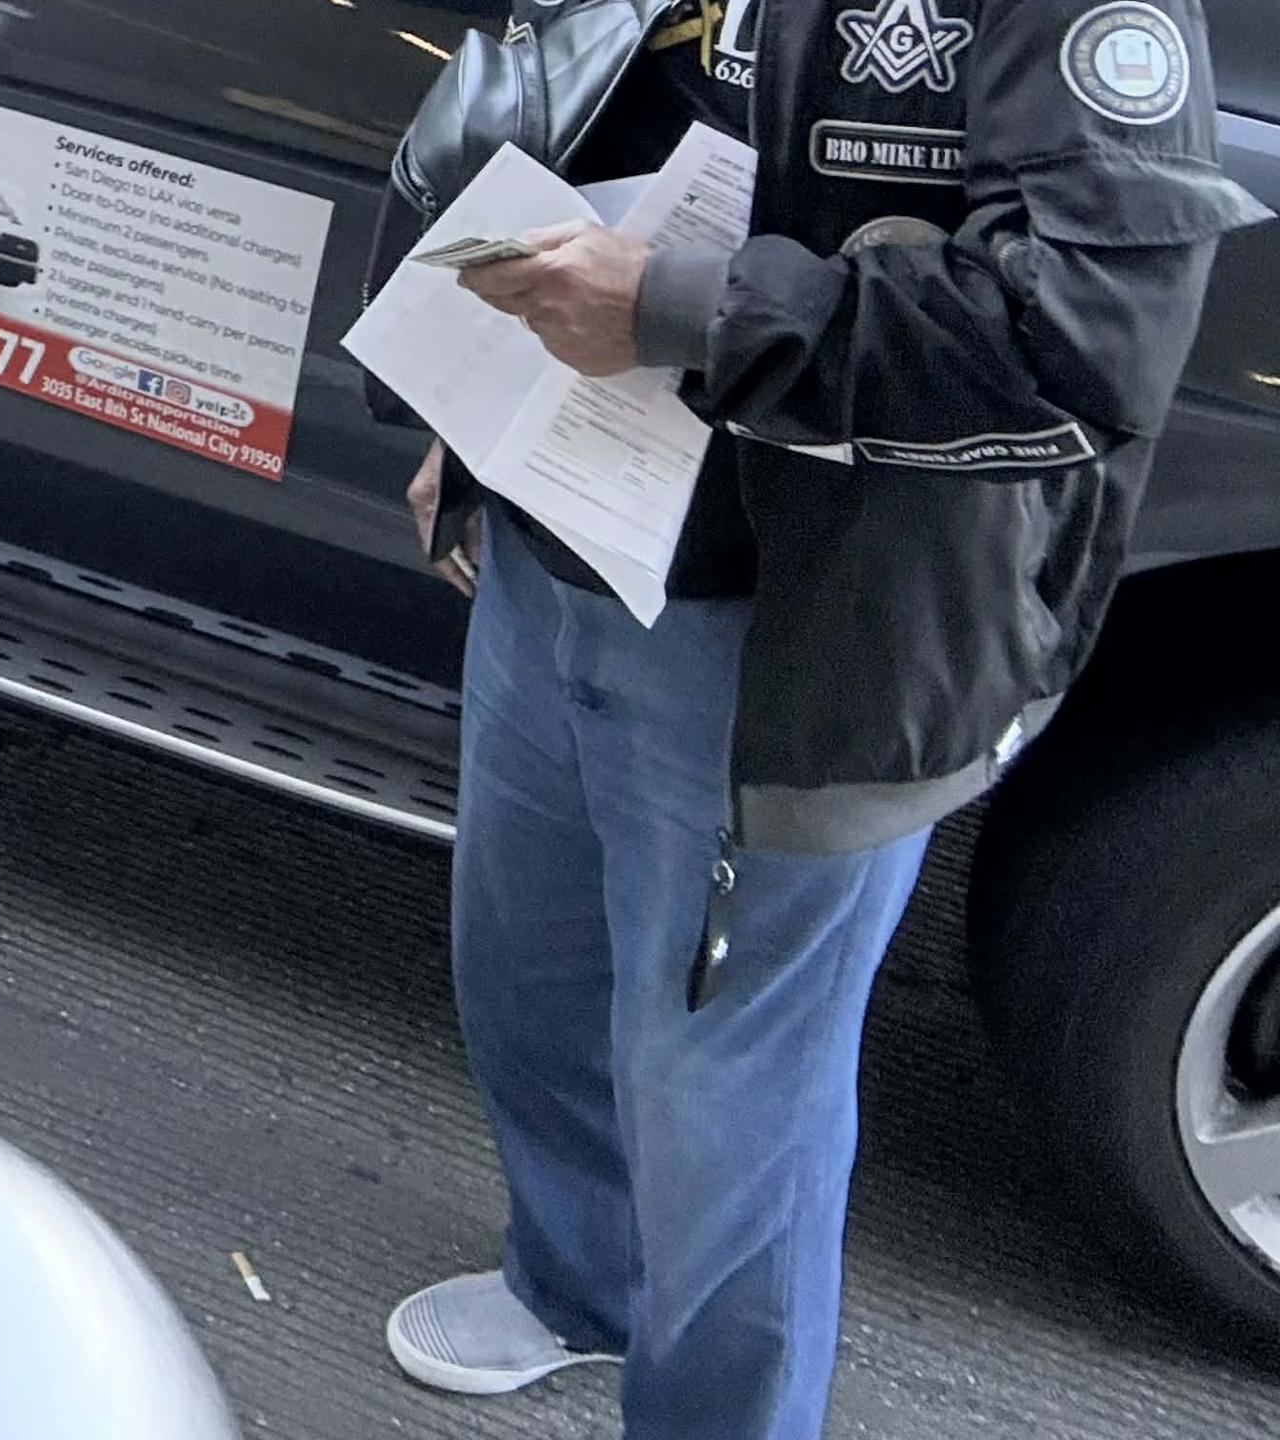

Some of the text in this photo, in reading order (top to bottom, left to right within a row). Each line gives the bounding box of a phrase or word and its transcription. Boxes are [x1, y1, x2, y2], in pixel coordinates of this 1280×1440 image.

[55, 136, 196, 189] Services offered:
[826, 137, 867, 162] BRO
[870, 142, 926, 168] MIKE
[63, 163, 88, 180] San
[91, 171, 130, 194] Diego
[131, 183, 146, 197] to
[149, 188, 176, 206] LAX
[177, 197, 204, 214] vice
[57, 204, 209, 265] Minimum 2 passengers
[60, 183, 147, 220] Door-to-Door
[172, 216, 241, 248] additional
[50, 247, 85, 268] other
[101, 242, 159, 269] exclusive
[161, 261, 207, 284] service
[235, 284, 287, 312] waiting
[288, 300, 308, 316] for
[48, 268, 57, 281] 2
[57, 271, 112, 301] luggage
[113, 290, 139, 307] and
[148, 301, 219, 335] hand-carry
[222, 326, 246, 344] per
[247, 334, 296, 360] person
[67, 296, 101, 317] extra
[43, 307, 242, 384] Passenger decides pickup time
[78, 350, 137, 380] Google
[74, 387, 104, 411] East
[131, 406, 146, 425] St
[146, 412, 206, 447] National
[206, 432, 239, 462] City
[239, 443, 281, 472] 91950
[1012, 444, 1059, 456] FINE
